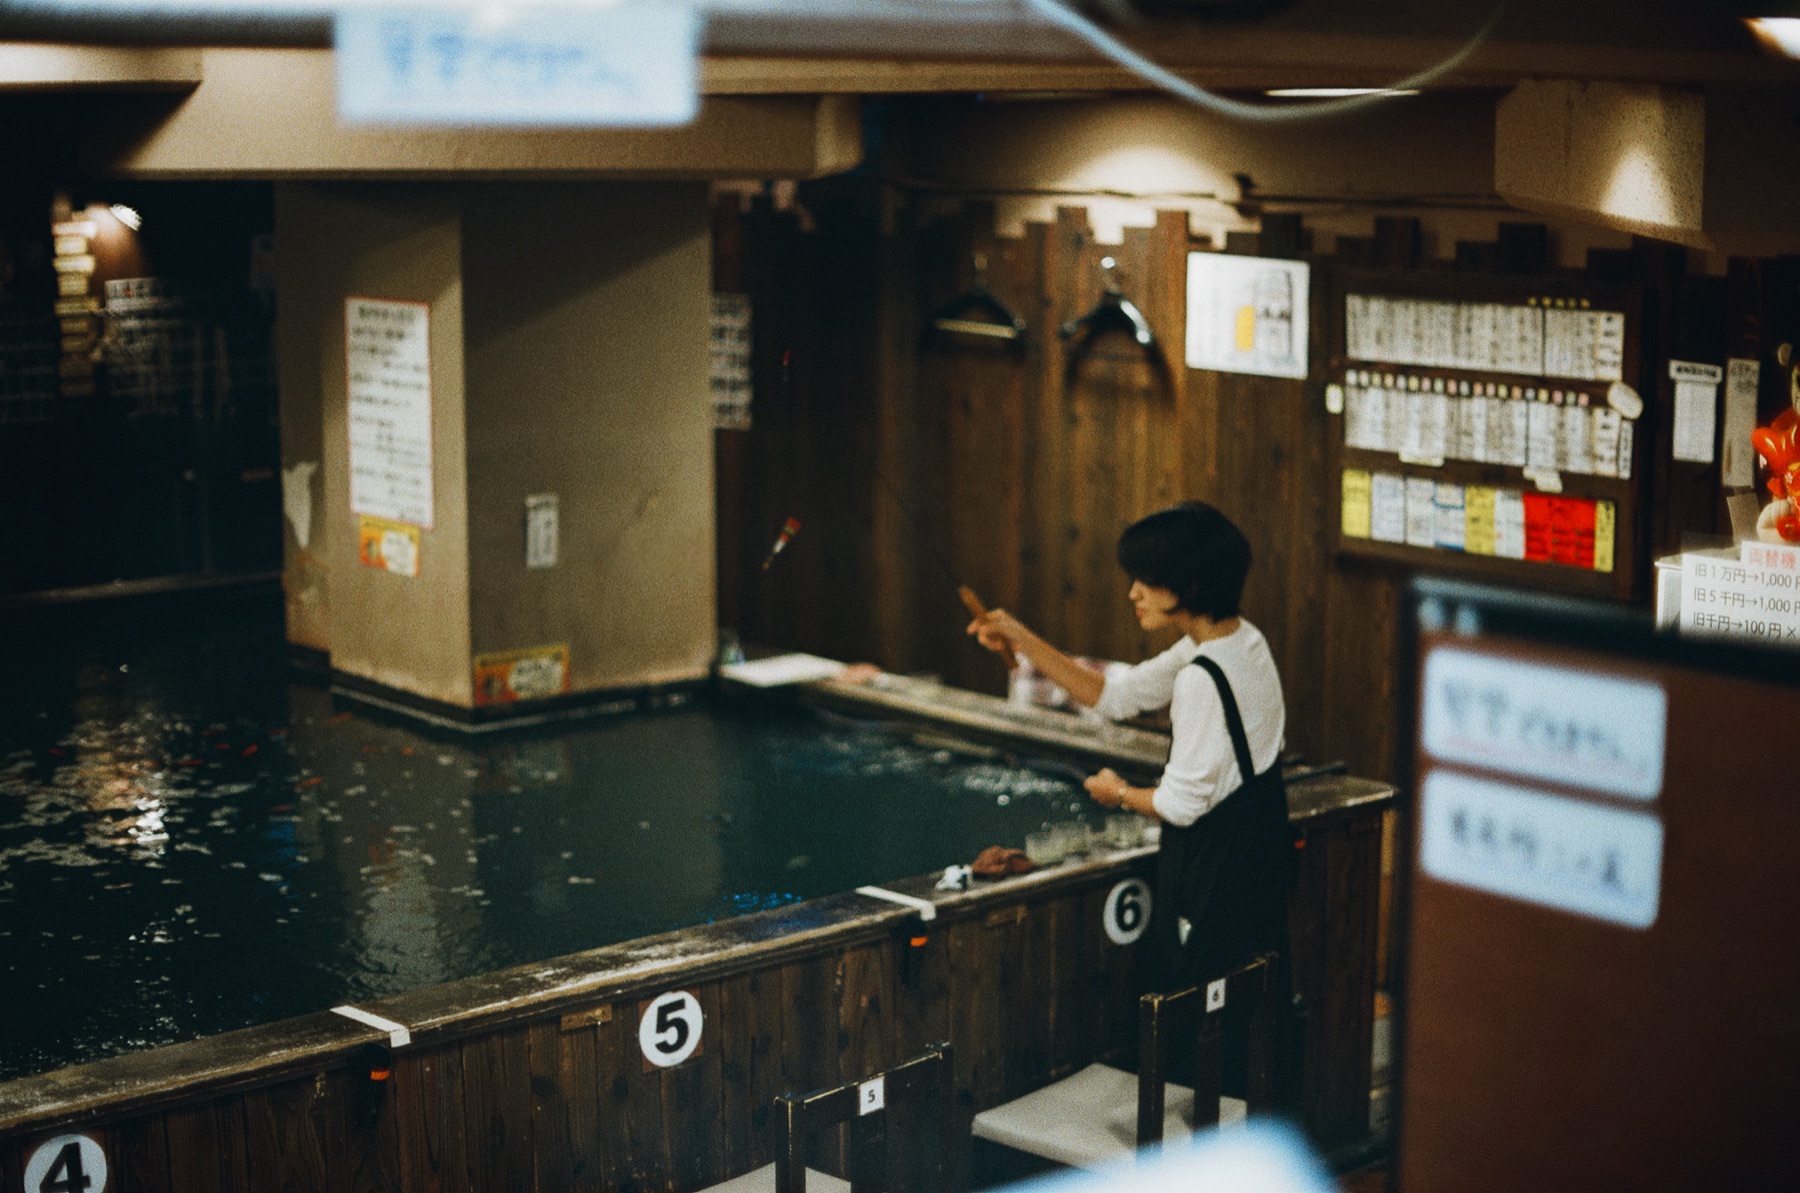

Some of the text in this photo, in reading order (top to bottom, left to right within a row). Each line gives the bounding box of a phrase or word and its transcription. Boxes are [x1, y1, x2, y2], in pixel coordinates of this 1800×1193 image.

[1116, 885, 1141, 932] 6
[655, 998, 689, 1054] 5
[868, 1089, 876, 1104] 5
[39, 1142, 92, 1193] 4
